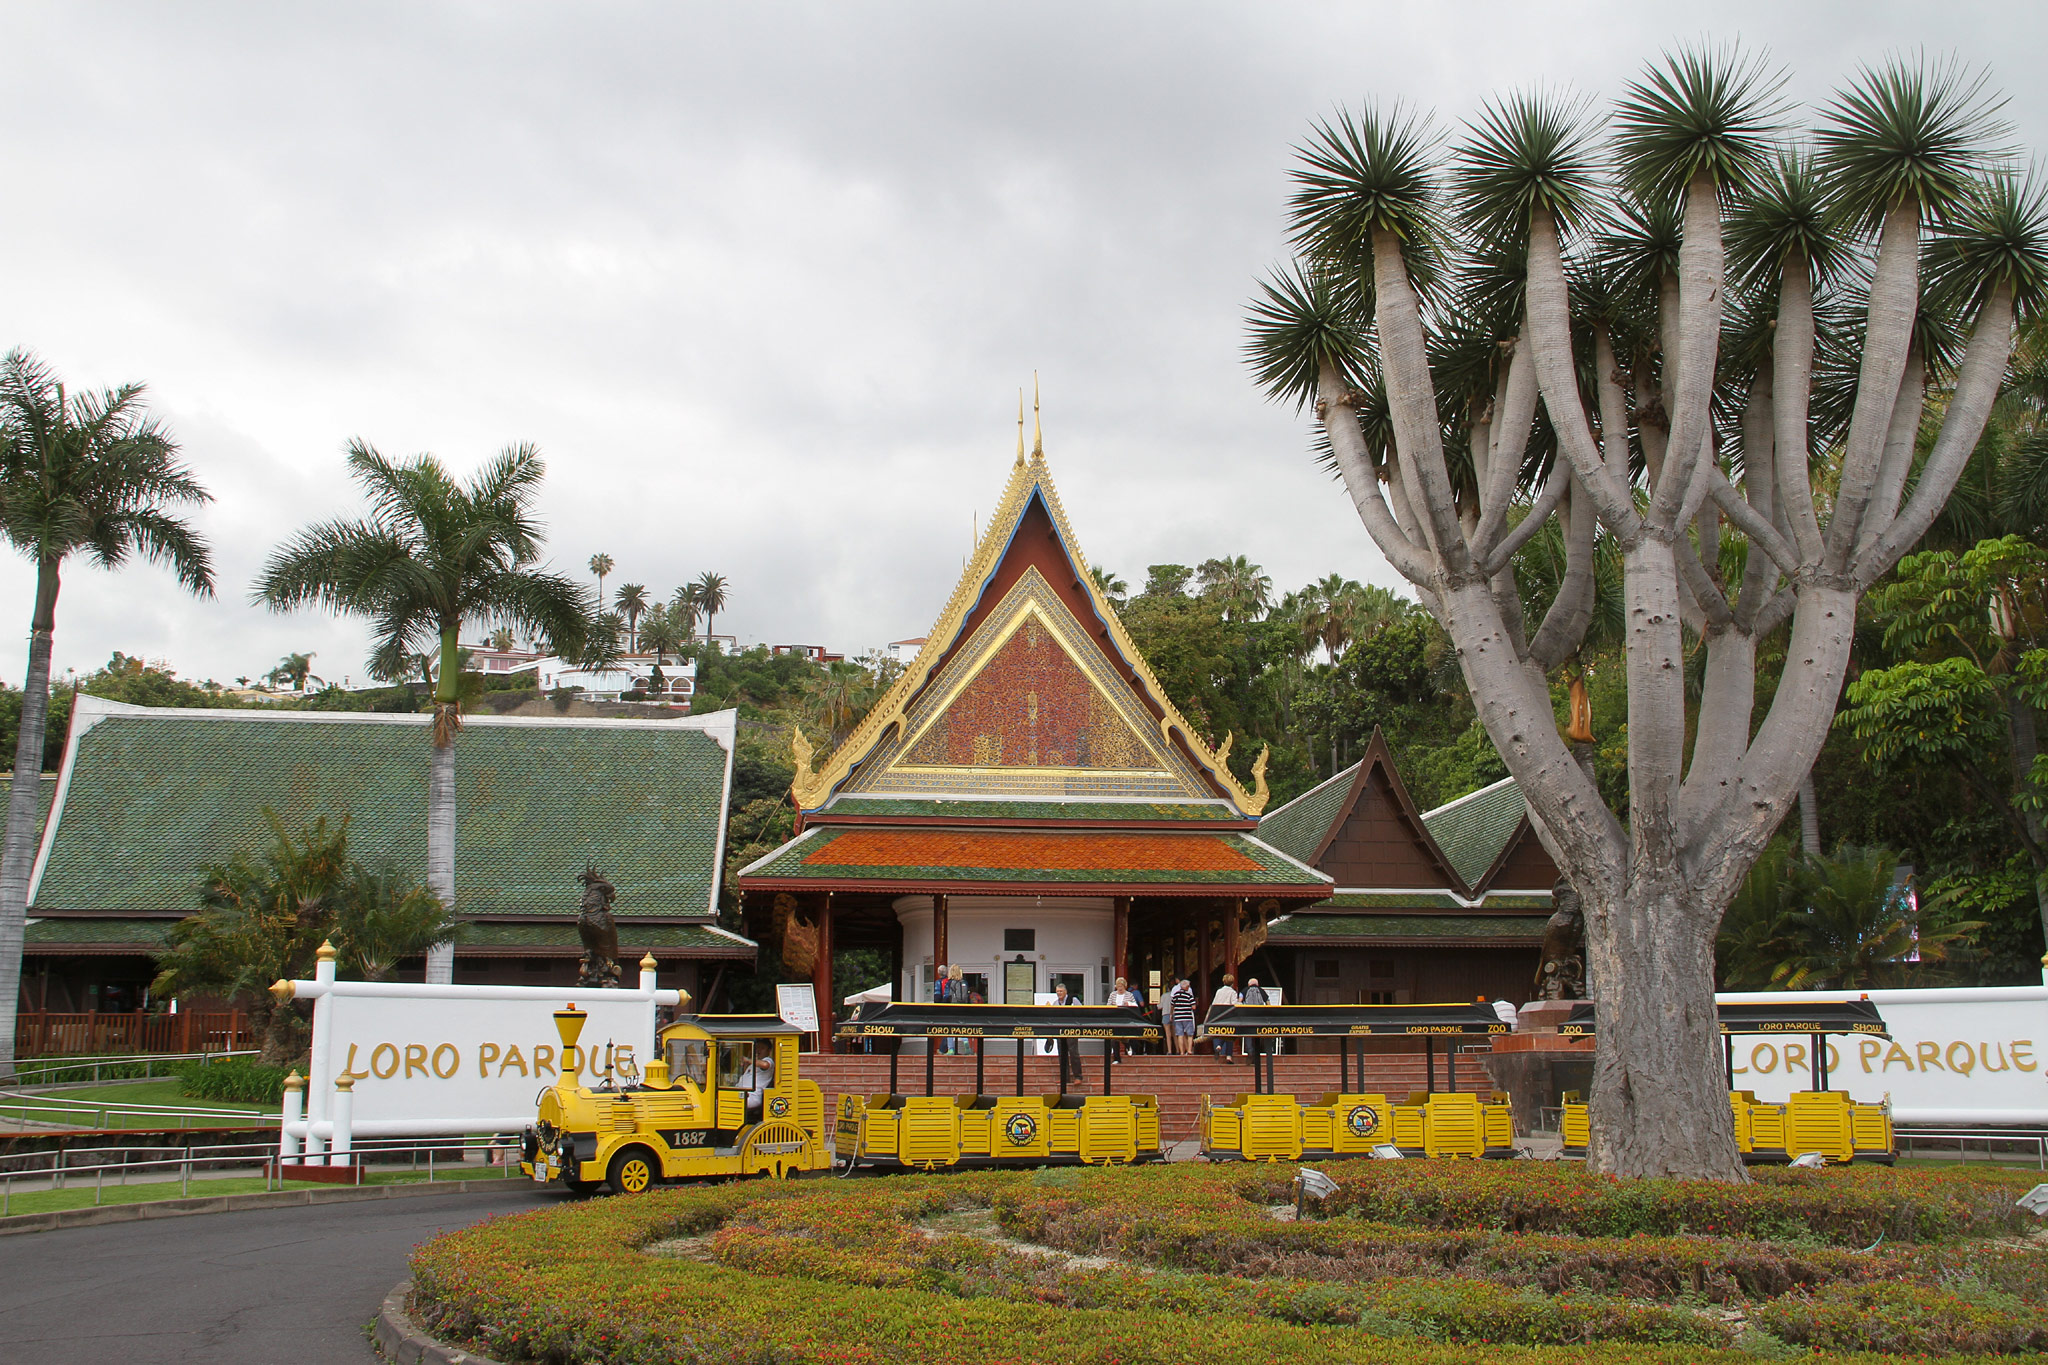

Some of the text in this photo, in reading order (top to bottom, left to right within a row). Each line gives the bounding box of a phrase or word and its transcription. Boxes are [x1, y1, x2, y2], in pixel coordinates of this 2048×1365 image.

[864, 1025, 895, 1034] SHOW
[926, 1026, 984, 1035] LORO PARQUE
[1208, 1026, 1236, 1035] SHOW
[1256, 1026, 1314, 1035] LORO PARQUE
[1406, 1025, 1463, 1034] LORO PARQUE
[1488, 1024, 1506, 1033] ZOO
[1563, 1025, 1582, 1034] ZOO
[1758, 1022, 1821, 1031] LORO PARQUE
[1852, 1023, 1882, 1032] SHOW
[1059, 1028, 1114, 1036] LORO PARQUE
[1143, 1027, 1159, 1037] ZOO
[346, 1042, 460, 1080] LORO
[1859, 1039, 2037, 1078] PARQUE
[673, 1131, 706, 1146] 1887
